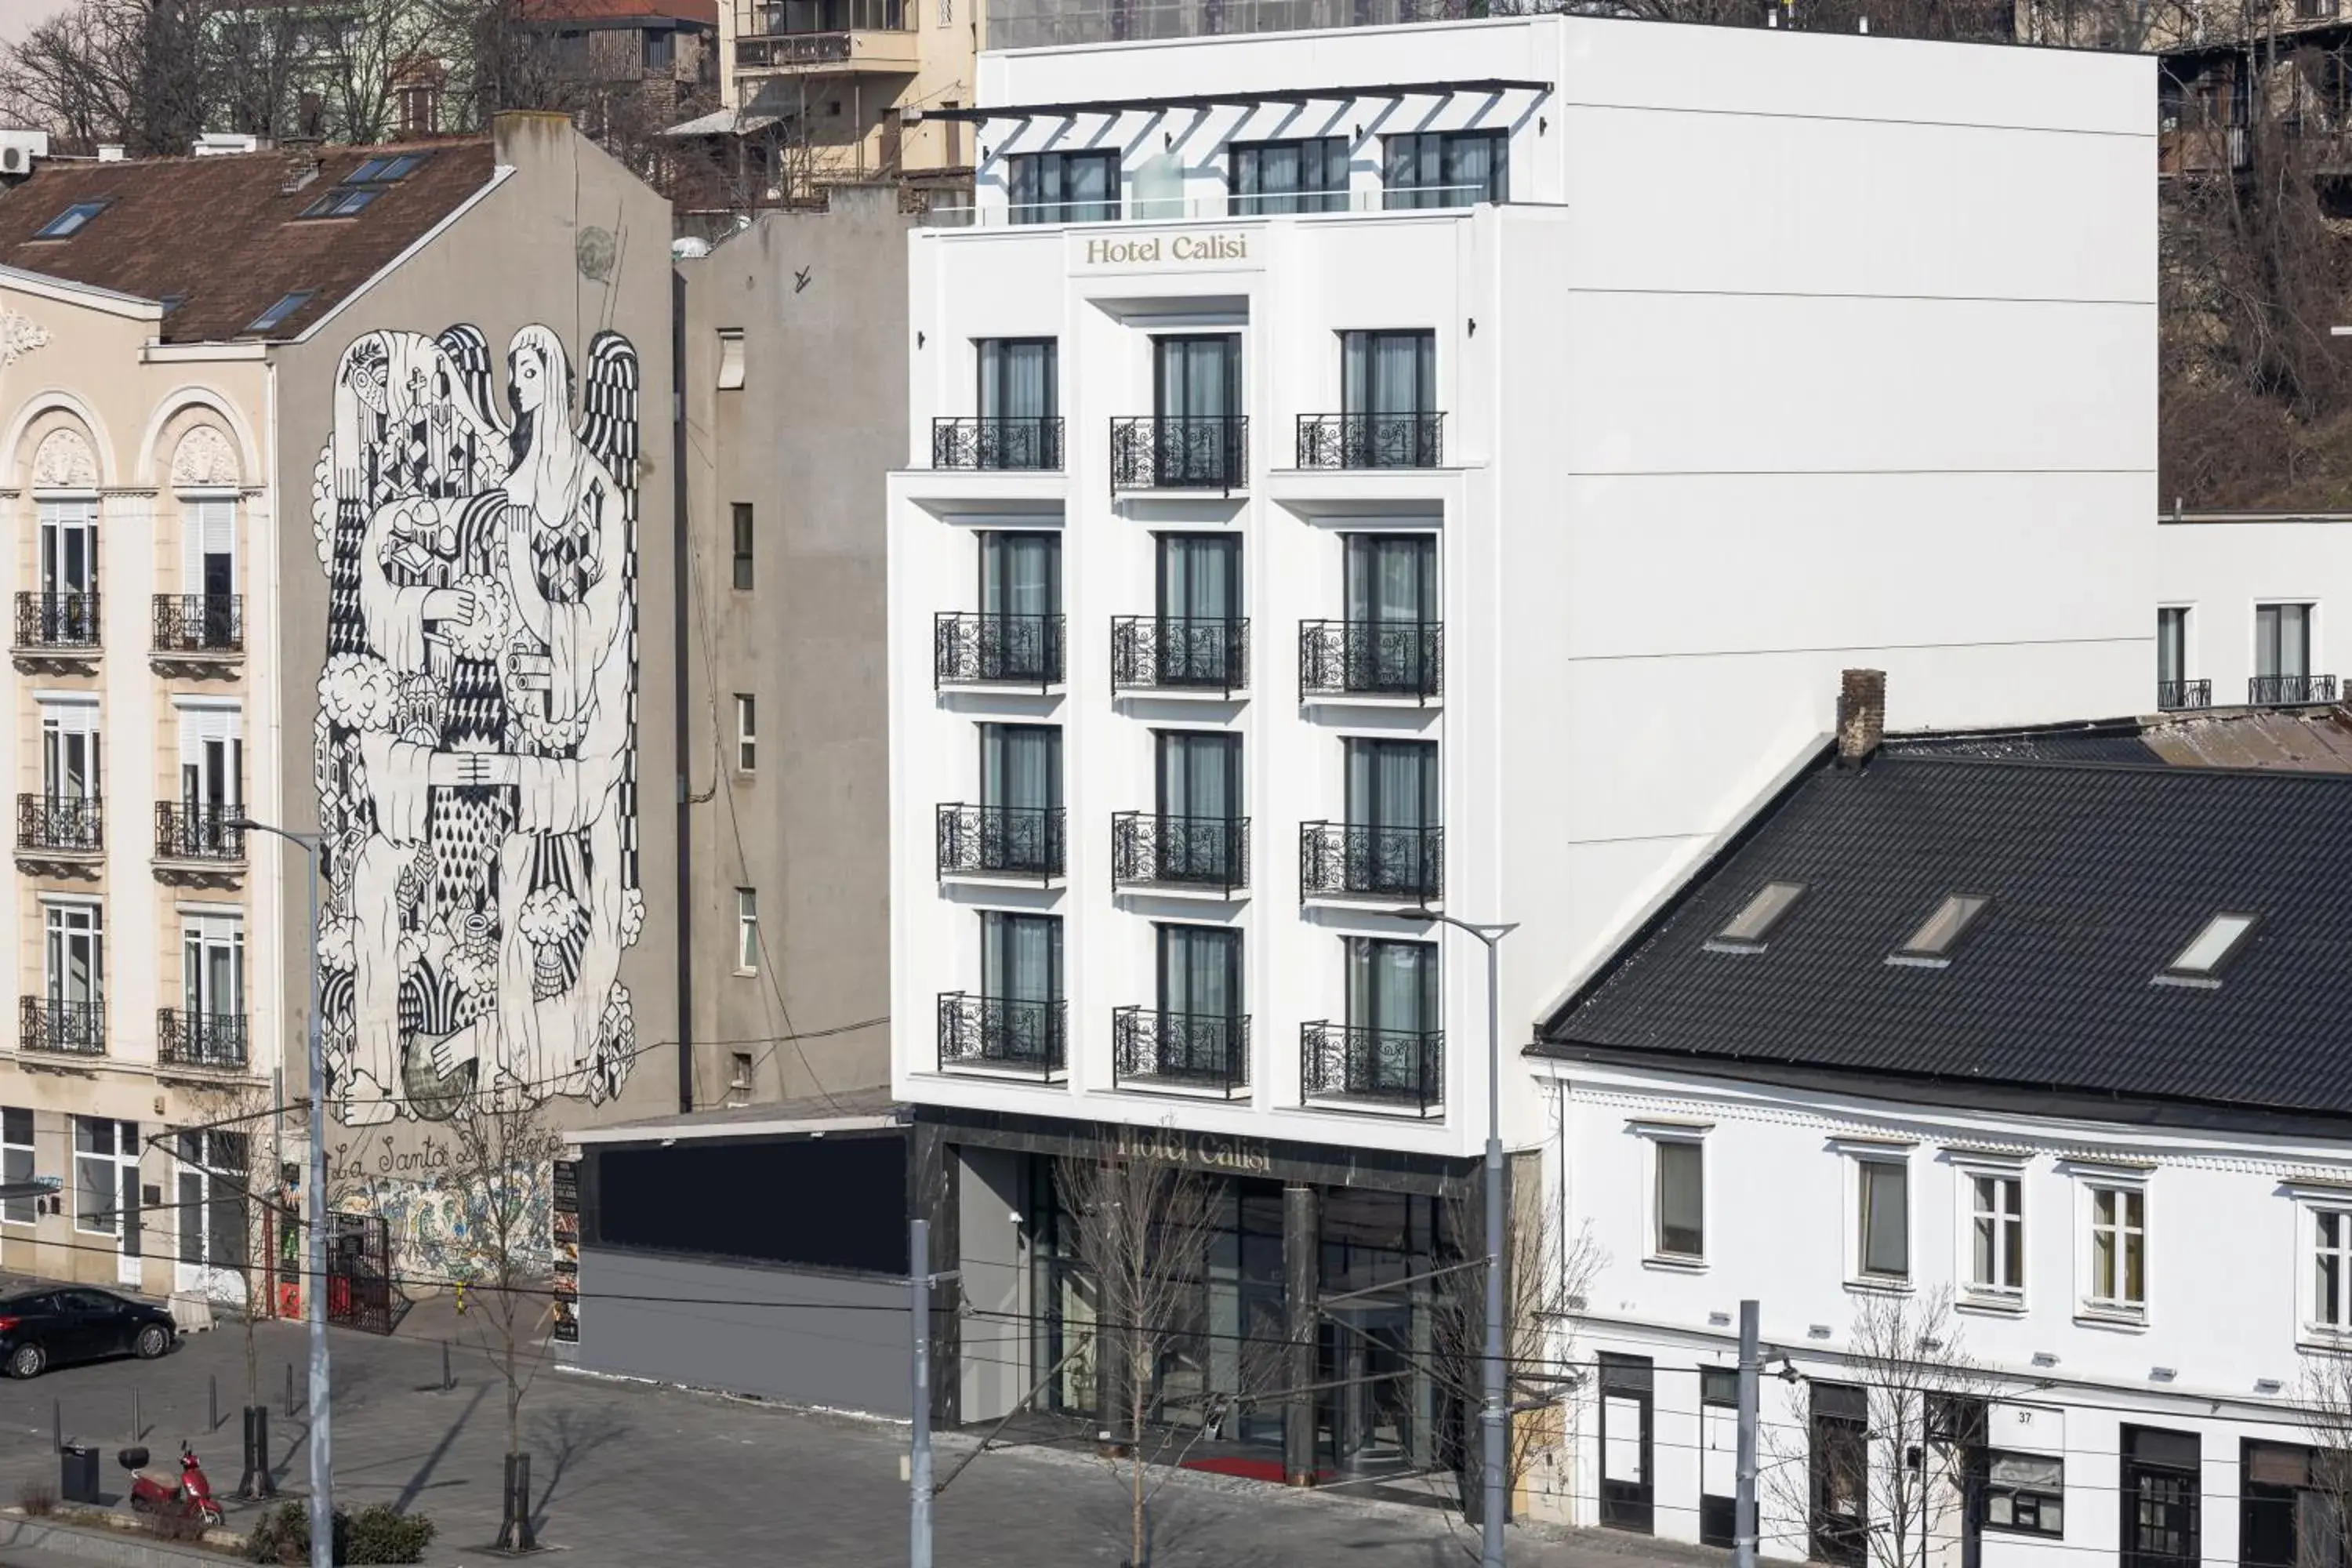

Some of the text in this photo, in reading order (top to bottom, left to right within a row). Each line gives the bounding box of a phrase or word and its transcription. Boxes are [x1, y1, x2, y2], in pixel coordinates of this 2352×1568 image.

[1087, 233, 1248, 264] Hotel Calisi
[331, 1142, 367, 1180] La
[379, 1134, 448, 1173] Santa
[1116, 1126, 1270, 1171] Hotel Calisi
[2019, 1412, 2032, 1423] 37
